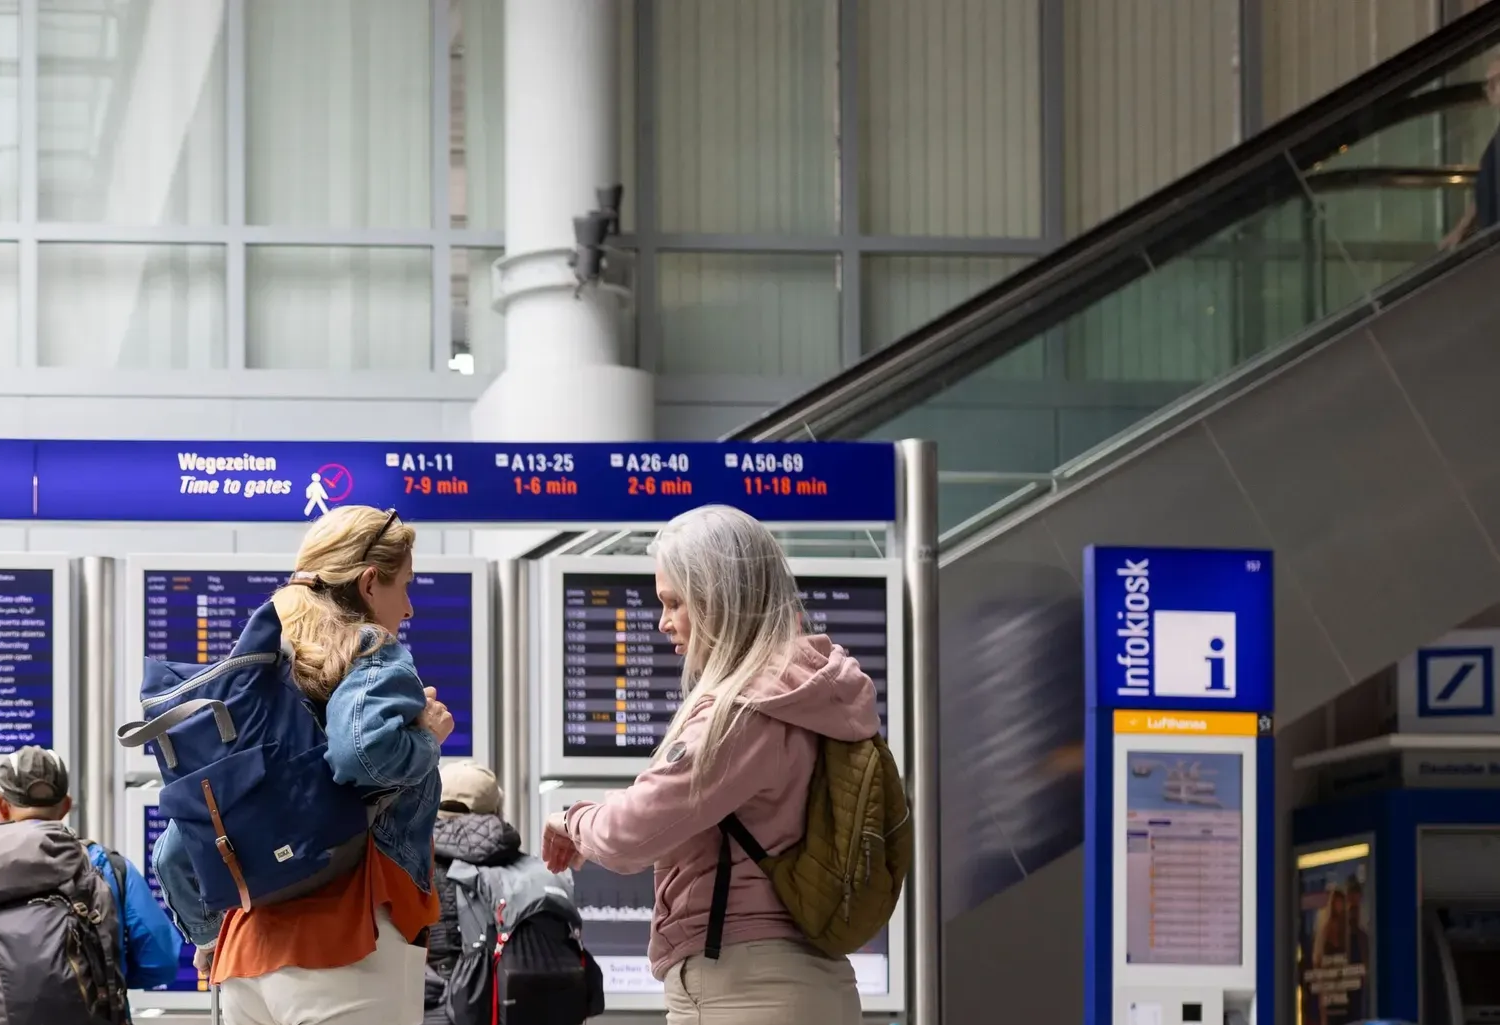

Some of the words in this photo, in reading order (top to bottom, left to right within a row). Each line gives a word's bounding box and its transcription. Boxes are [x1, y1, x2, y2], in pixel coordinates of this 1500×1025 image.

[178, 453, 276, 474] Wegezeiten
[179, 476, 219, 494] Time
[223, 477, 241, 494] to
[244, 477, 292, 498] gates
[404, 477, 432, 494] 7-9
[437, 477, 468, 494] min
[514, 477, 541, 494] 1-6
[546, 477, 577, 494] min
[628, 477, 656, 494] 2-6
[661, 477, 692, 494] min
[744, 477, 791, 494] 11-18
[796, 477, 828, 494] min
[1117, 558, 1150, 696] Infokiosk
